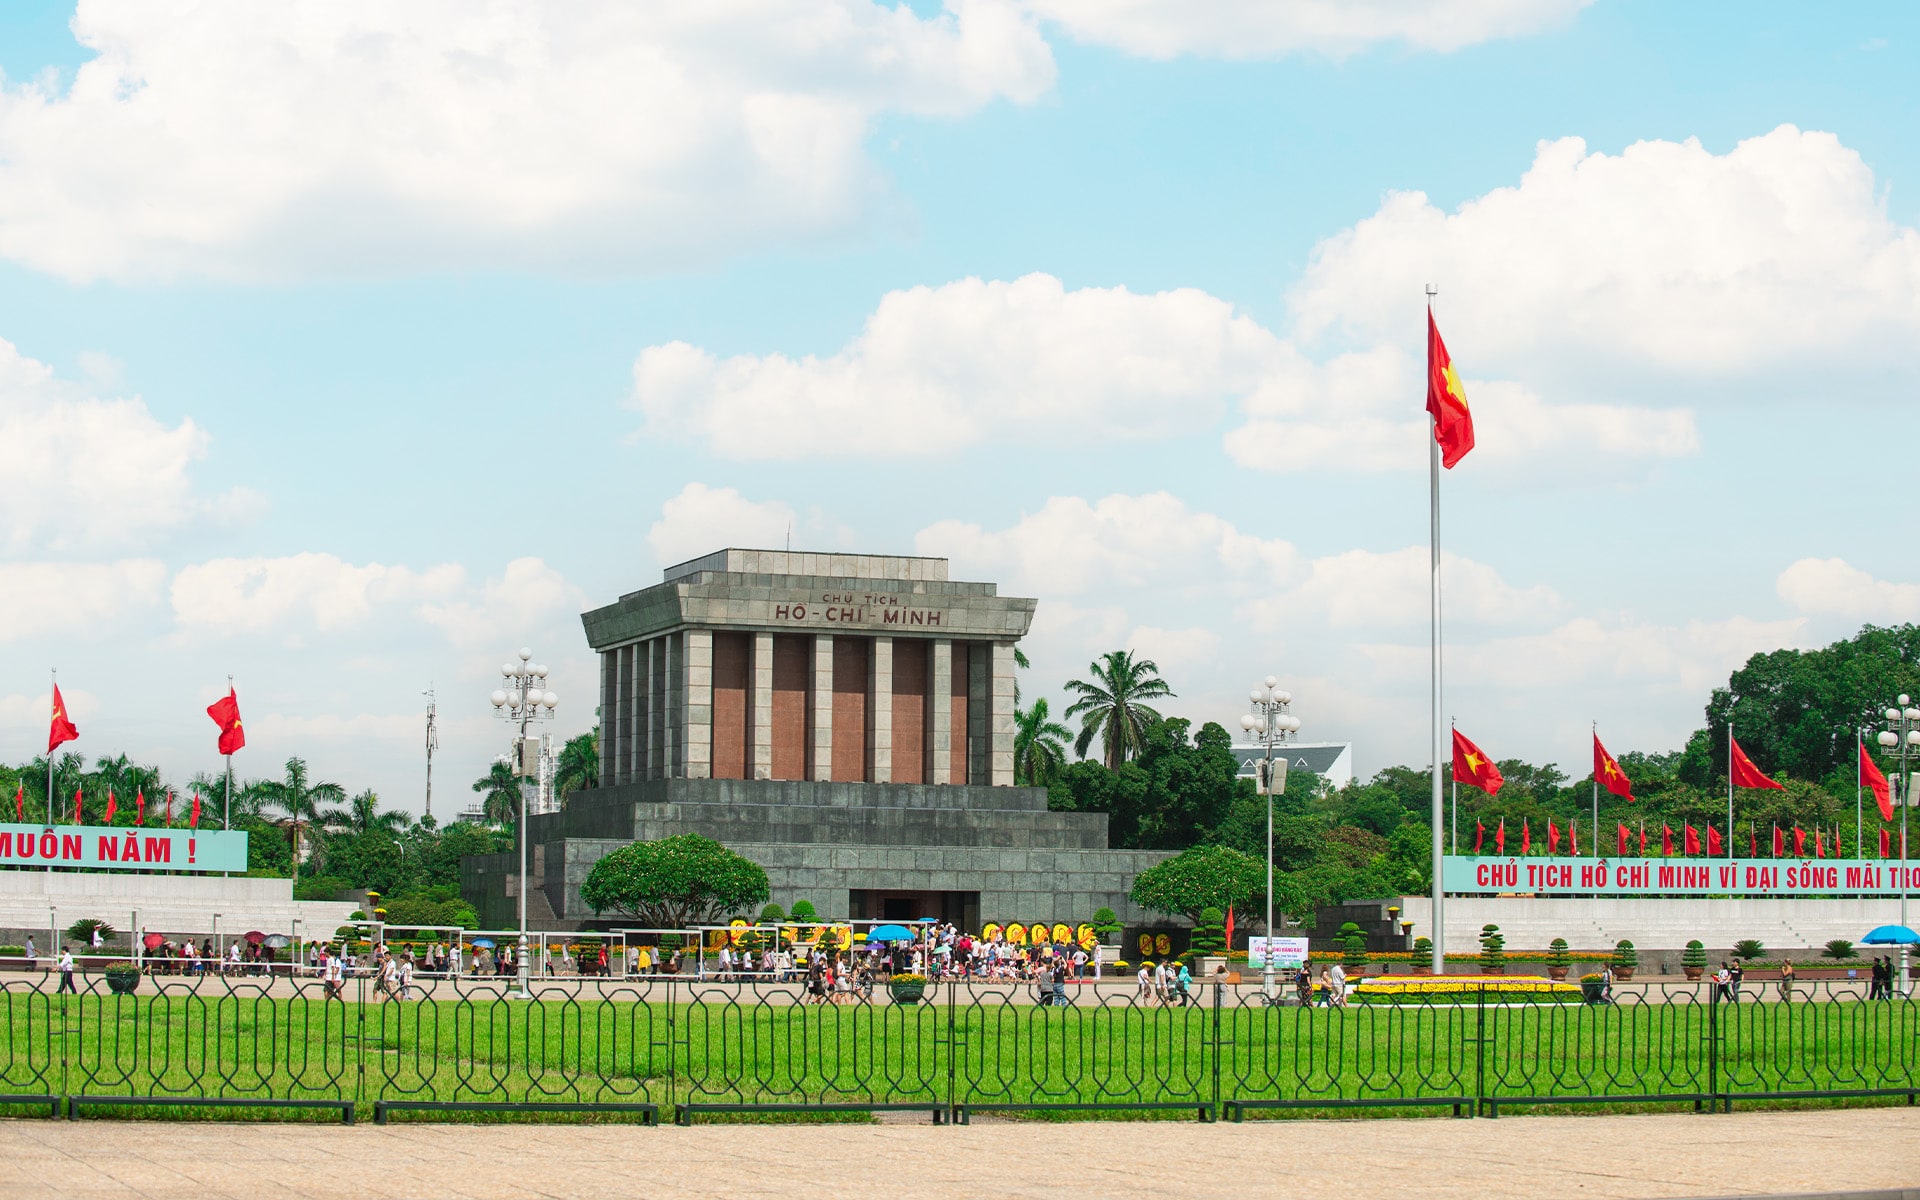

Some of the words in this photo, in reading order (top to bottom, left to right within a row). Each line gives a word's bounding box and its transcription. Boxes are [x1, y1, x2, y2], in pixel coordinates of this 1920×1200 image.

[98, 831, 171, 863] NĂM
[188, 838, 196, 864] !
[1476, 858, 1518, 887] CHỦ
[1526, 864, 1573, 892] TỊCH
[1581, 858, 1608, 888] HỒ
[1616, 861, 1650, 889] CHÍ
[1658, 865, 1710, 889] MINH
[1719, 861, 1738, 889] VĨ
[1745, 866, 1778, 893] ĐẠI
[1786, 860, 1838, 889] SỐNG
[1845, 863, 1881, 889] MÃI
